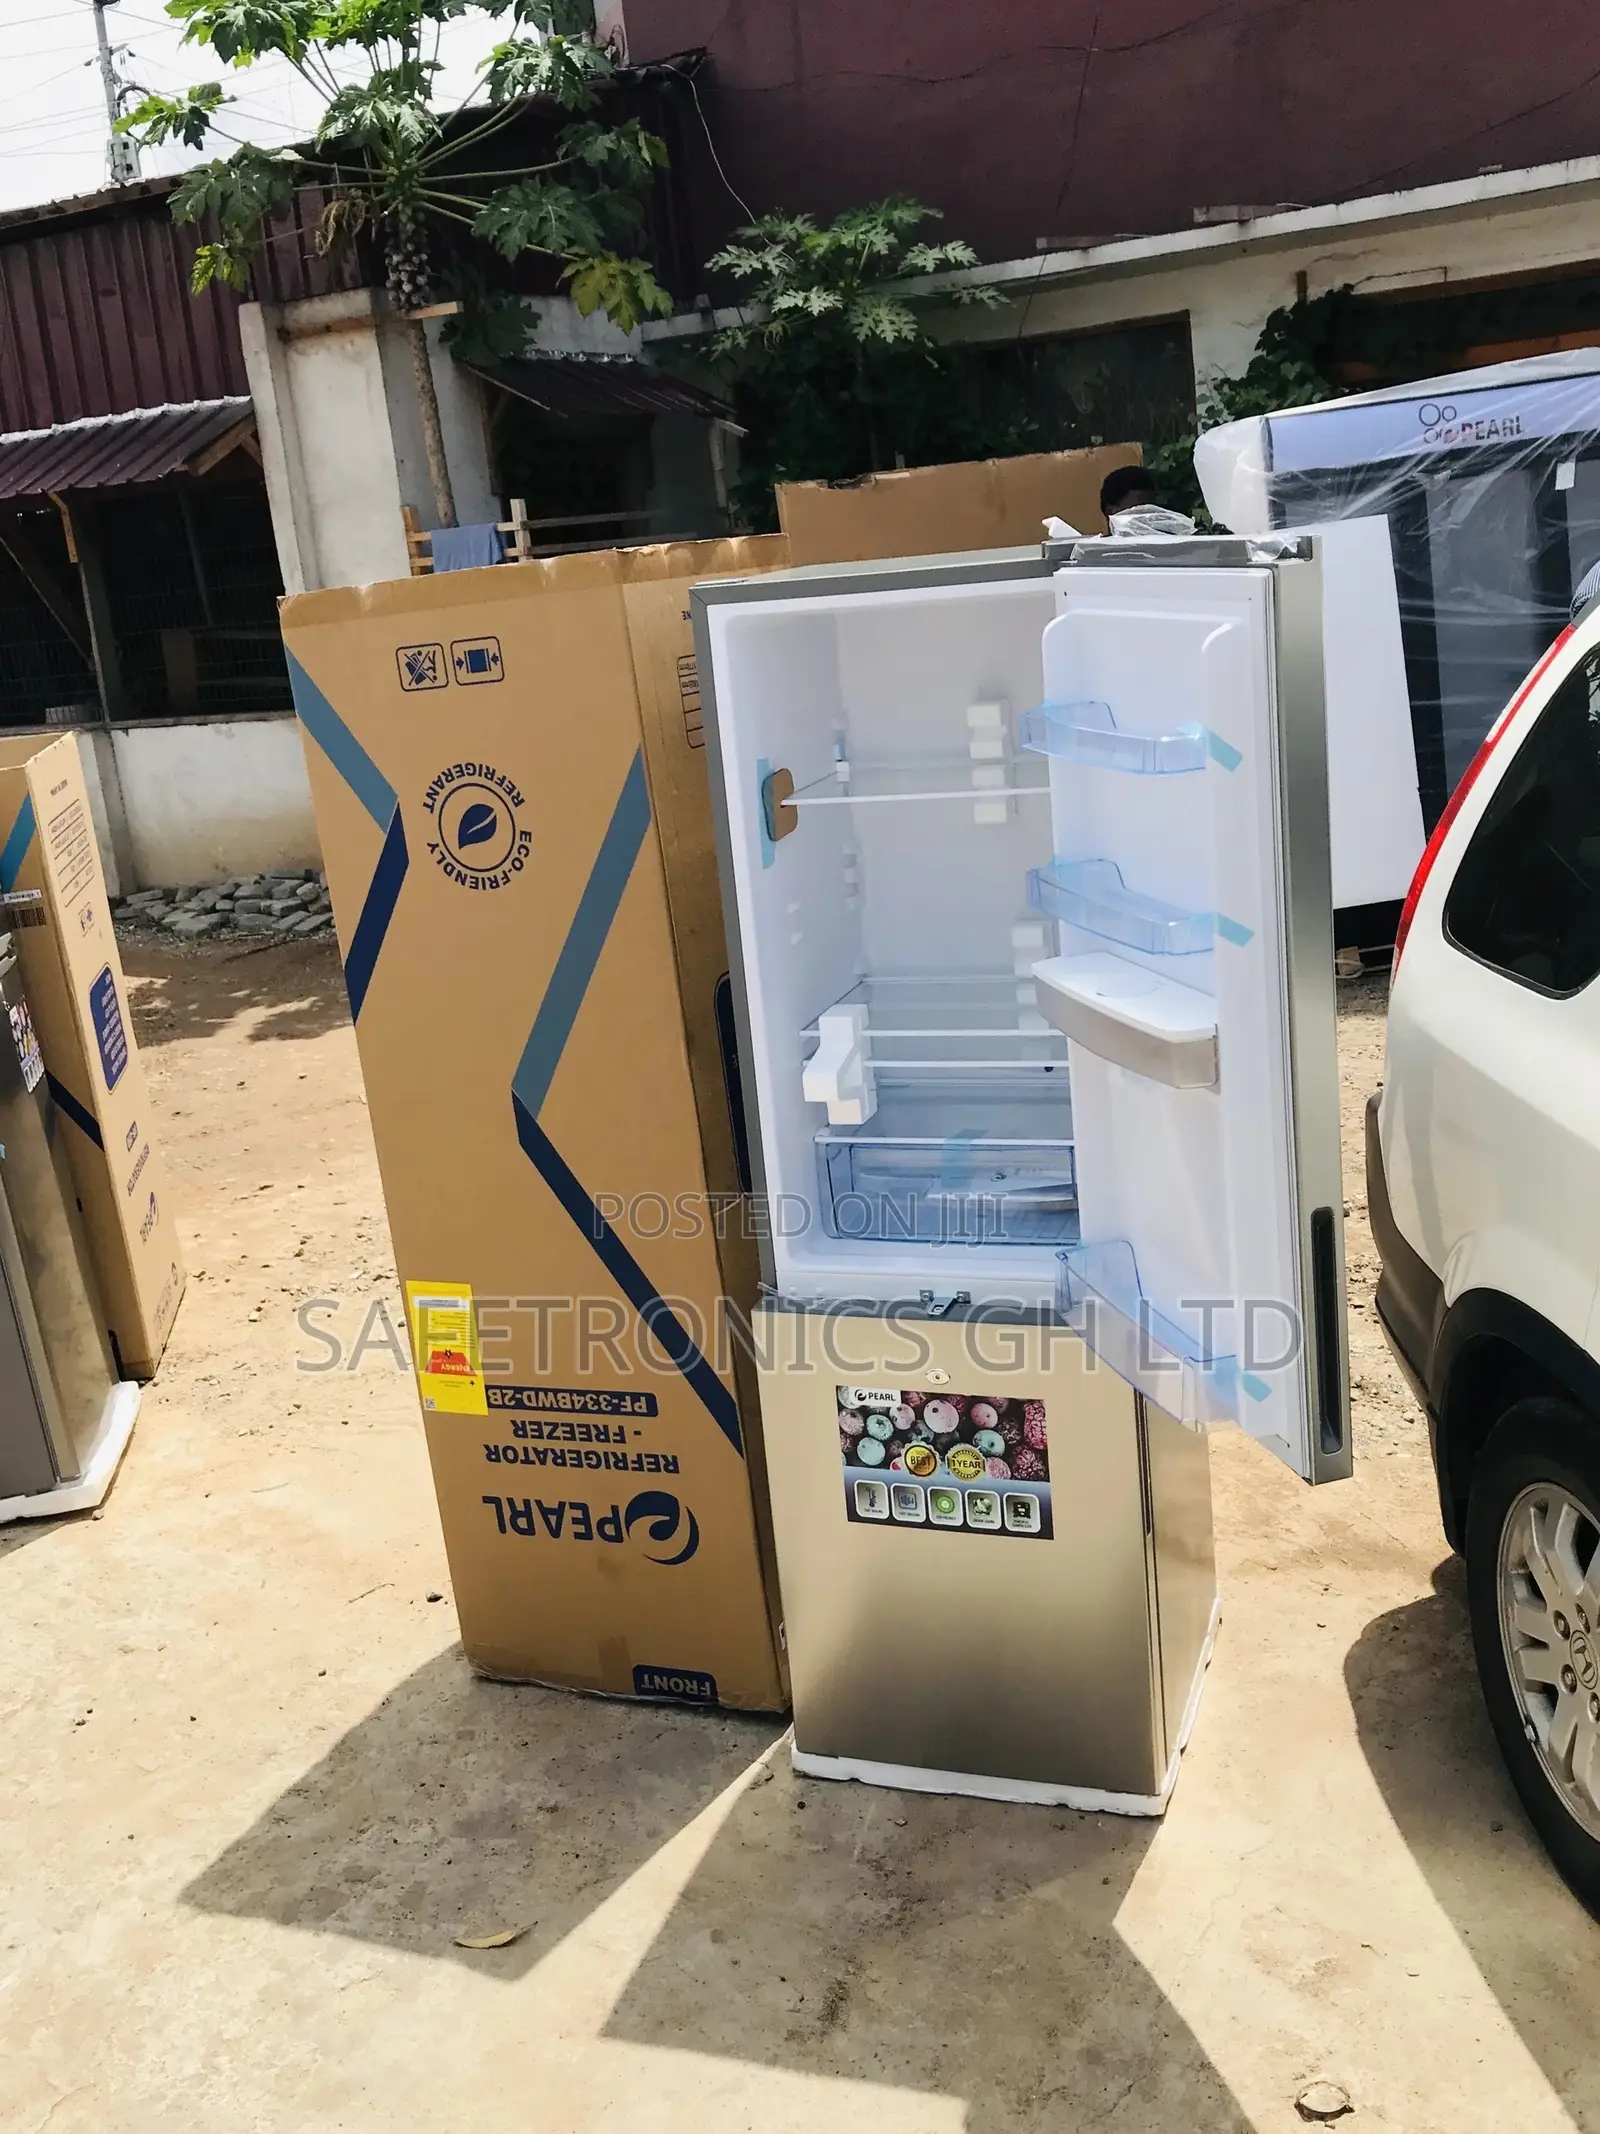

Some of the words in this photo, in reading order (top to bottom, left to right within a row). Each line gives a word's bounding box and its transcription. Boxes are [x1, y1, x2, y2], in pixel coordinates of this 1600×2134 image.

[1461, 415, 1523, 442] PEARL
[423, 762, 525, 814] REFRIGERANT
[427, 830, 532, 890] ECO-FRIENDLY
[486, 1389, 649, 1413] PF-334BWD-2B
[868, 1392, 896, 1401] PEARL
[510, 1419, 627, 1444] FREEZER
[483, 1444, 680, 1474] REFRIGERATOR
[910, 1455, 931, 1466] BEST
[482, 1496, 624, 1543] PEARL
[641, 1674, 711, 1697] FRONT
